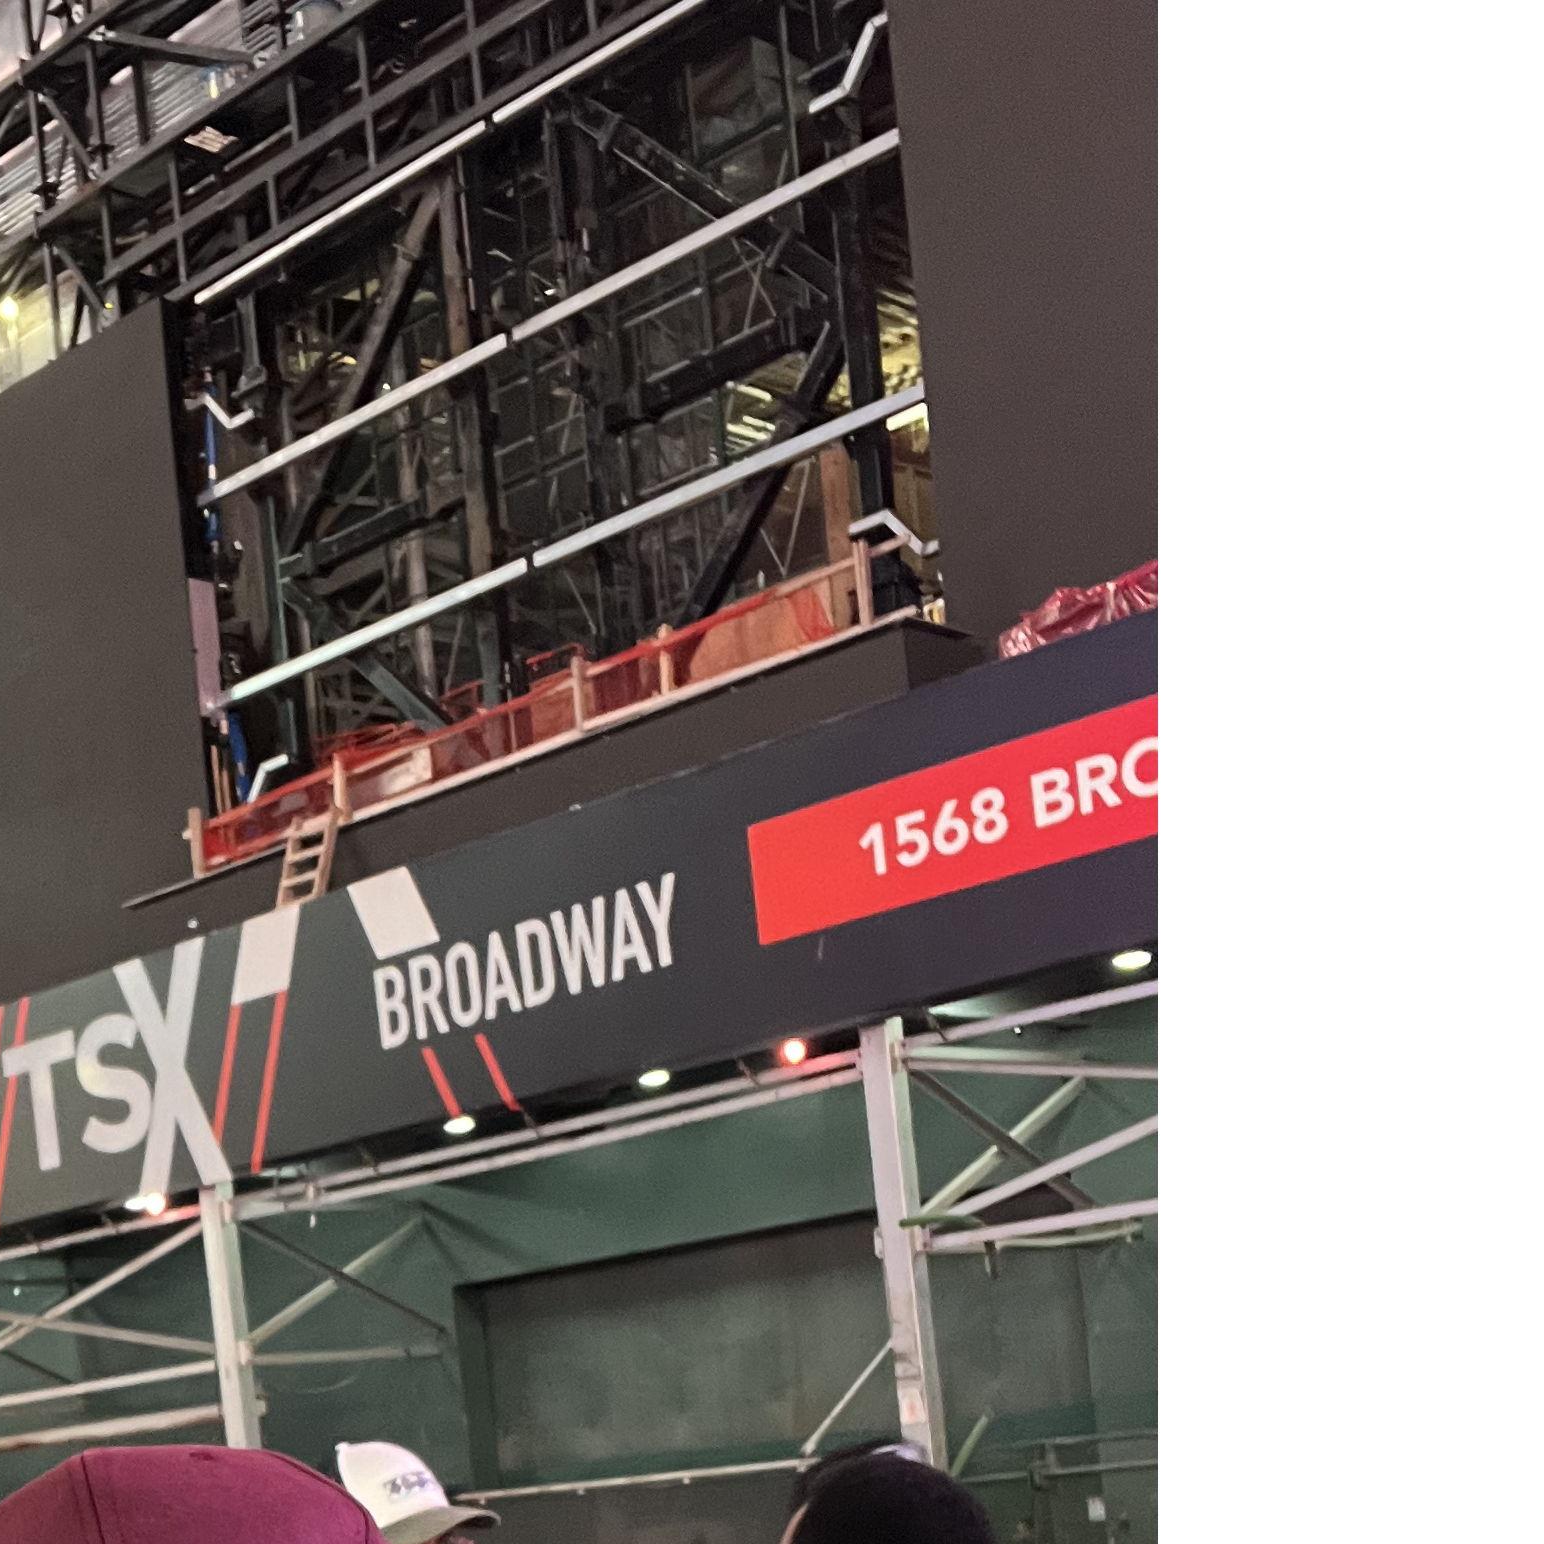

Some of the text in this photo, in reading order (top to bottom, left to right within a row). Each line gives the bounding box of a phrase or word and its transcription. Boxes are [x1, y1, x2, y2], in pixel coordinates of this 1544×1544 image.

[858, 786, 1009, 876] 1568
[2, 872, 675, 1198] TSX BROADWAY
